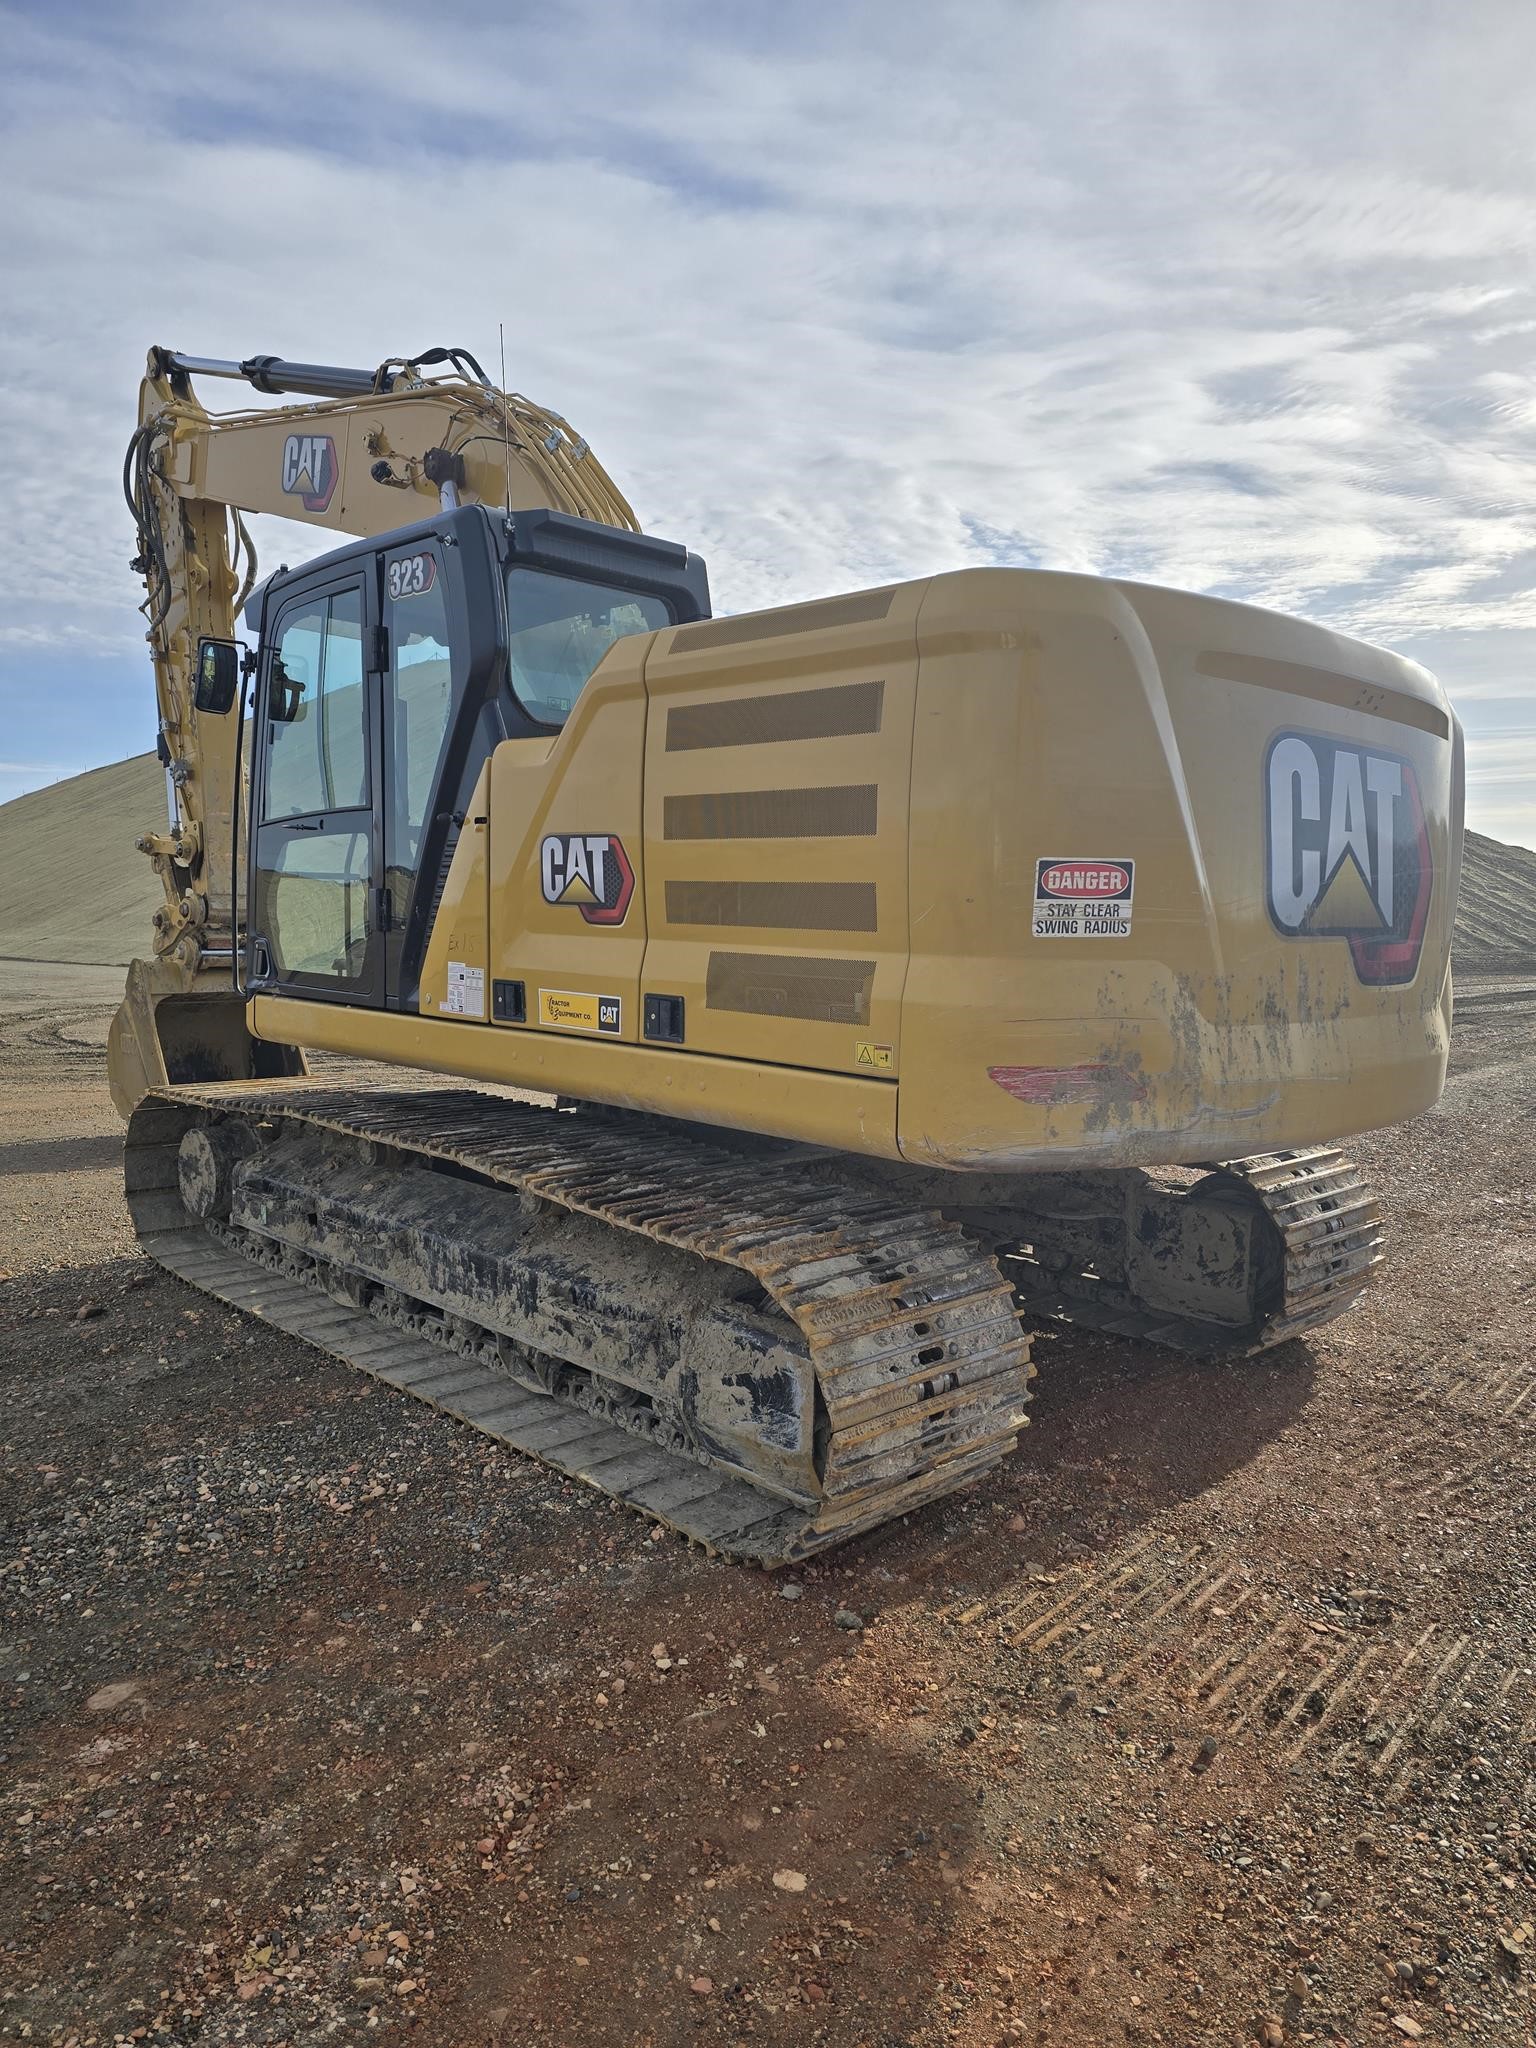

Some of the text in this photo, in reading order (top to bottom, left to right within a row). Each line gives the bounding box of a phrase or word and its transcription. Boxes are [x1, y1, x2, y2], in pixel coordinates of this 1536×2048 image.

[283, 436, 327, 494] CAT
[390, 556, 424, 598] 323
[1270, 738, 1401, 929] CAT
[542, 836, 609, 903] CAT
[1047, 870, 1123, 890] DANGER
[1047, 903, 1120, 918] STAY CLEAR
[1036, 920, 1129, 934] SWING RADIUS
[553, 1007, 582, 1021] EQUIPMENT
[600, 1005, 618, 1024] CAT
